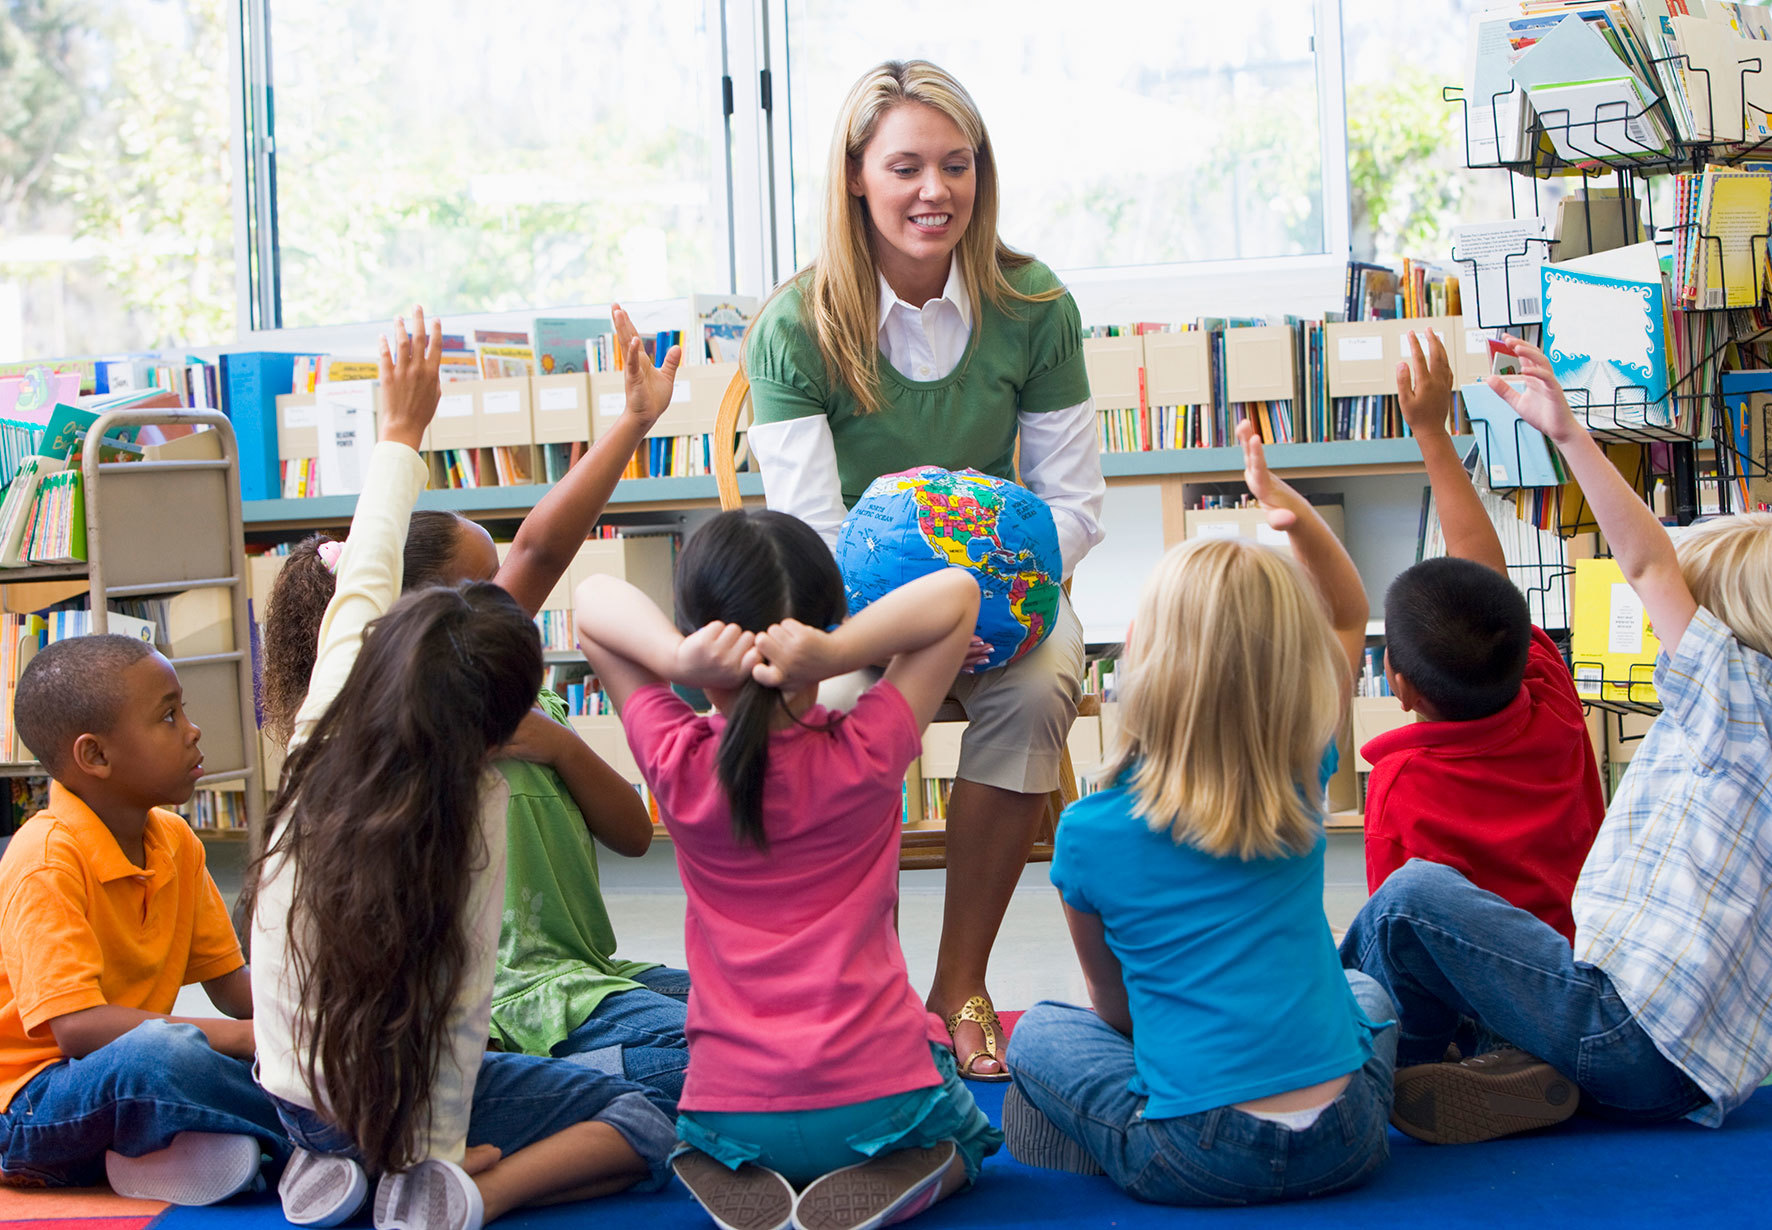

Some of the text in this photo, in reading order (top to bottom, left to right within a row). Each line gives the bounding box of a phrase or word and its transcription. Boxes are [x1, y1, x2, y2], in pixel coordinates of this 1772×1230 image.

[869, 504, 886, 513] NORTH
[855, 508, 895, 522] PACIFIC OCEAN
